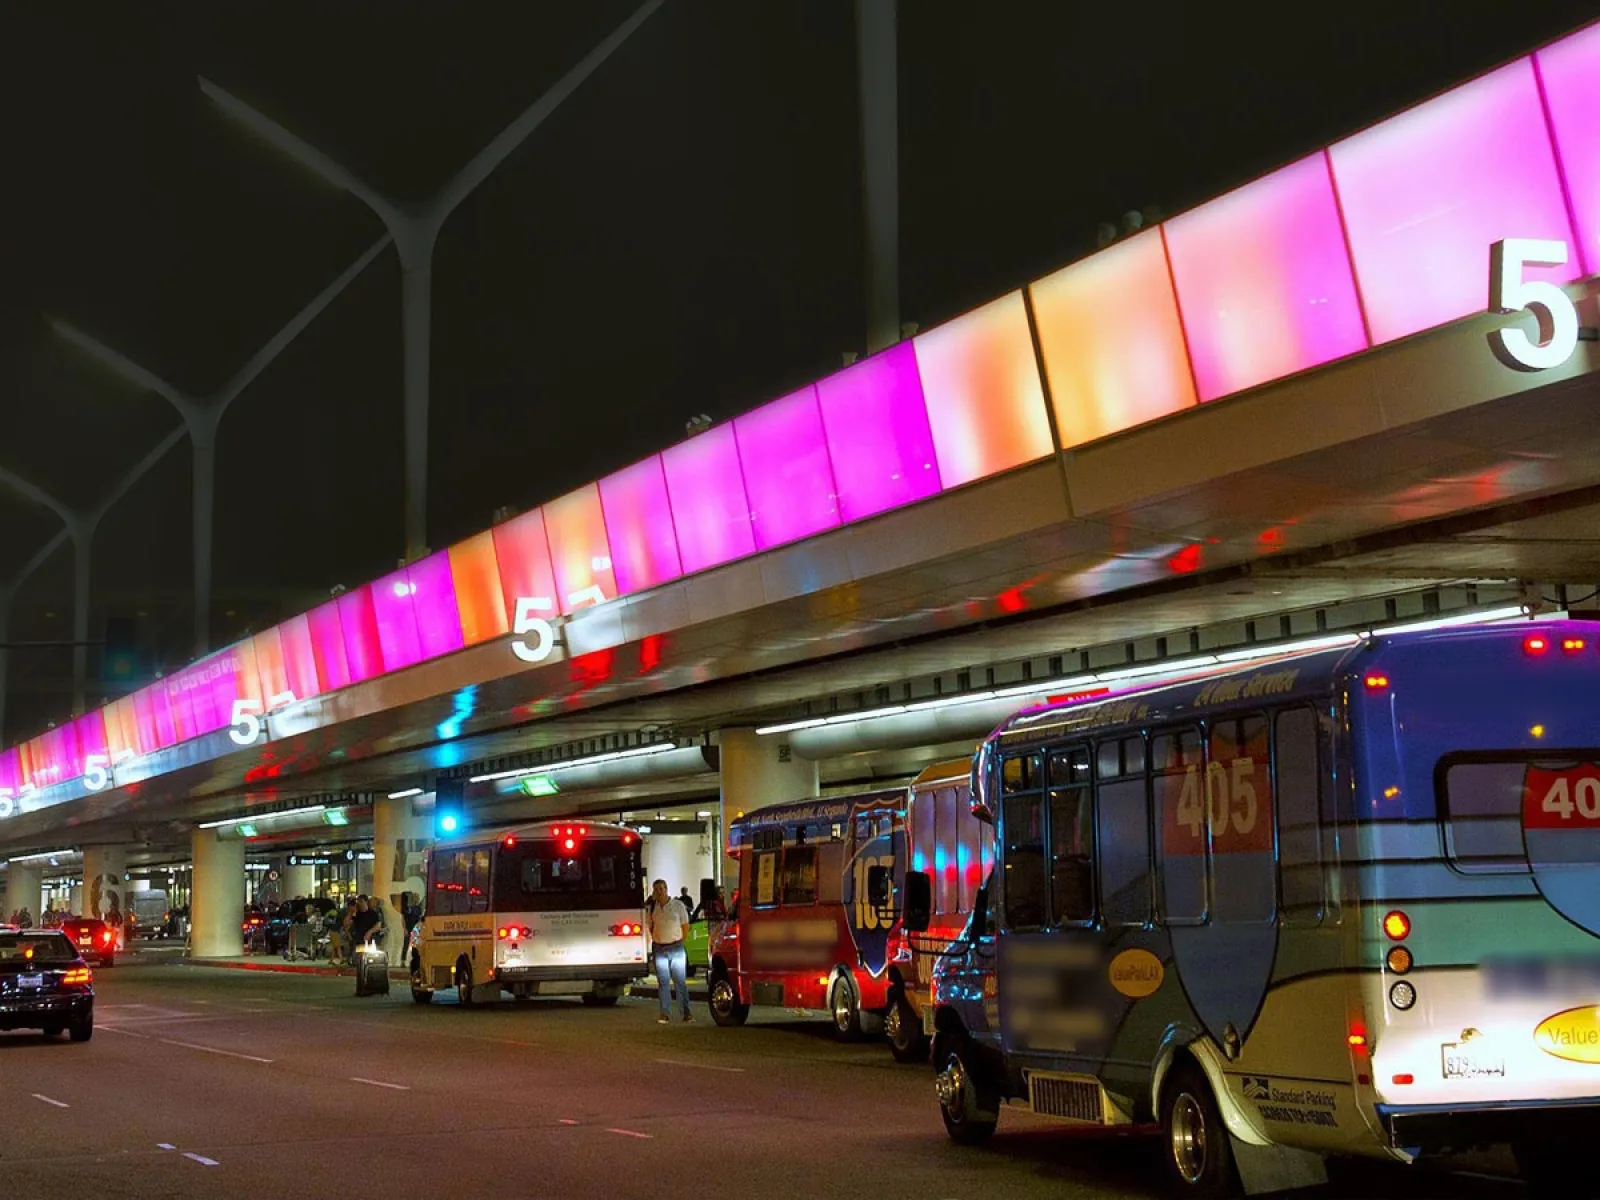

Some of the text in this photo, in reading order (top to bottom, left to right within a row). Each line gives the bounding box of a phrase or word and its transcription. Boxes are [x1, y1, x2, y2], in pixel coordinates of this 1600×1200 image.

[1488, 238, 1578, 371] 5
[511, 596, 554, 662] 5
[229, 699, 260, 745] 5
[83, 755, 108, 791] 5
[1176, 757, 1258, 838] 405
[1271, 1087, 1336, 1111] Standard Parking
